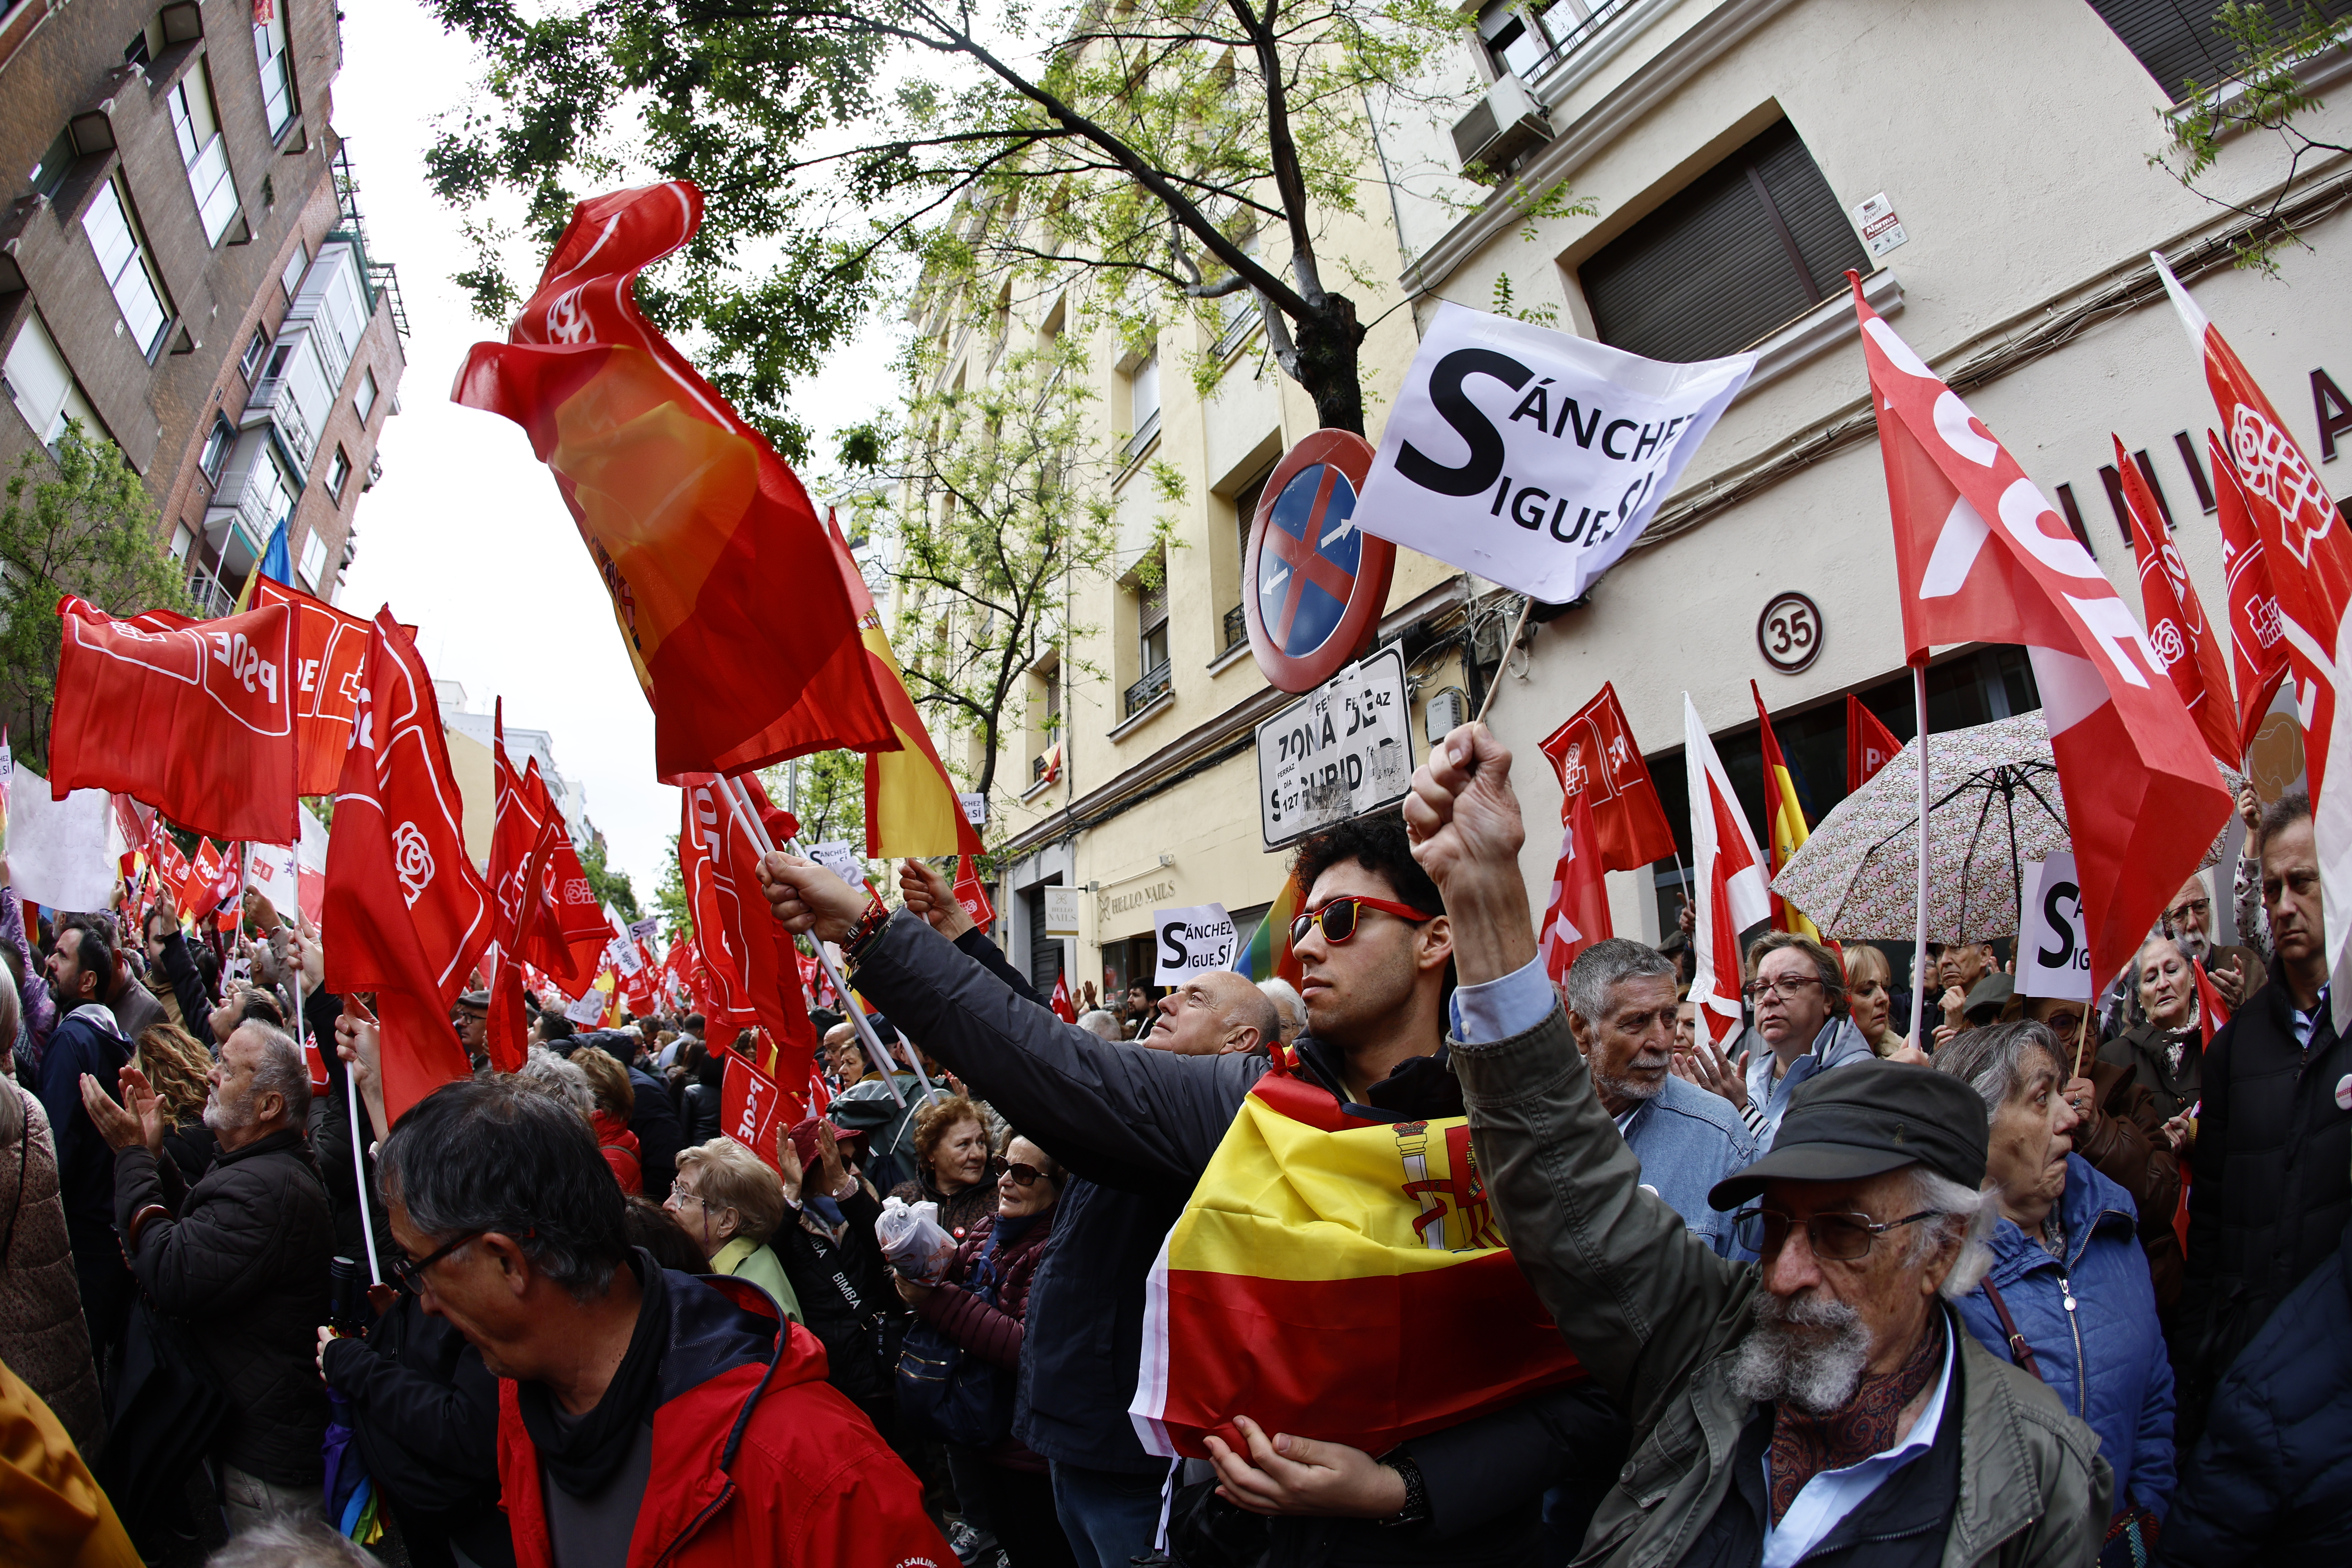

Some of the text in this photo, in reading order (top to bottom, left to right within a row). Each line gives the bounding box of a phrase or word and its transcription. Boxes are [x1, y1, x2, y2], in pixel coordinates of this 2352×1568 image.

[1866, 215, 1895, 235] Alarma
[1770, 609, 1812, 654] 35
[1277, 763, 1295, 779] FERRAZ
[1284, 780, 1292, 789] DÍA
[1283, 793, 1299, 812] 127
[973, 808, 981, 818] SÍ
[1112, 880, 1175, 914] HELLO NAILS
[1049, 913, 1076, 922] NAILS
[1162, 921, 1233, 969] SÁNCHEZ
[832, 1272, 861, 1310] BIMBA
